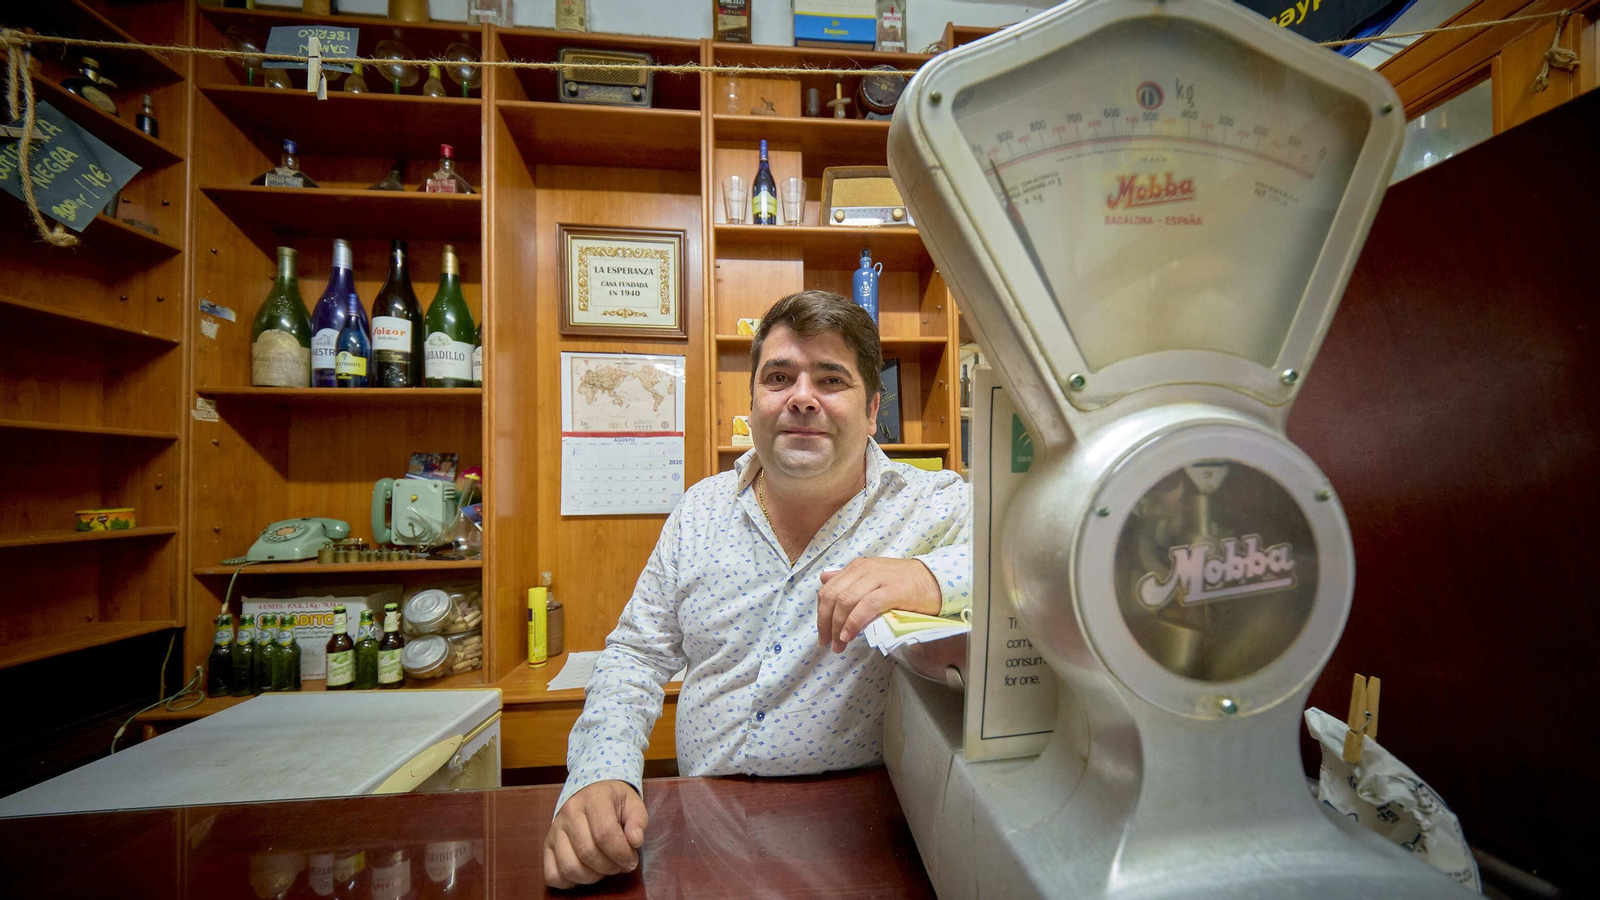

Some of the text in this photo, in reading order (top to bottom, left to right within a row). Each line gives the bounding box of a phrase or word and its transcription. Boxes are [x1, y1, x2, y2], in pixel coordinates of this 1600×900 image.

[299, 43, 350, 54] JAMN
[30, 146, 79, 190] NEGRA
[1106, 172, 1196, 208] Mobba
[1104, 215, 1153, 226] BADALONA
[1165, 213, 1203, 226] ESPAÑA
[372, 326, 407, 337] Solear
[1136, 534, 1296, 609] Mobba
[1004, 674, 1041, 687] for one.
